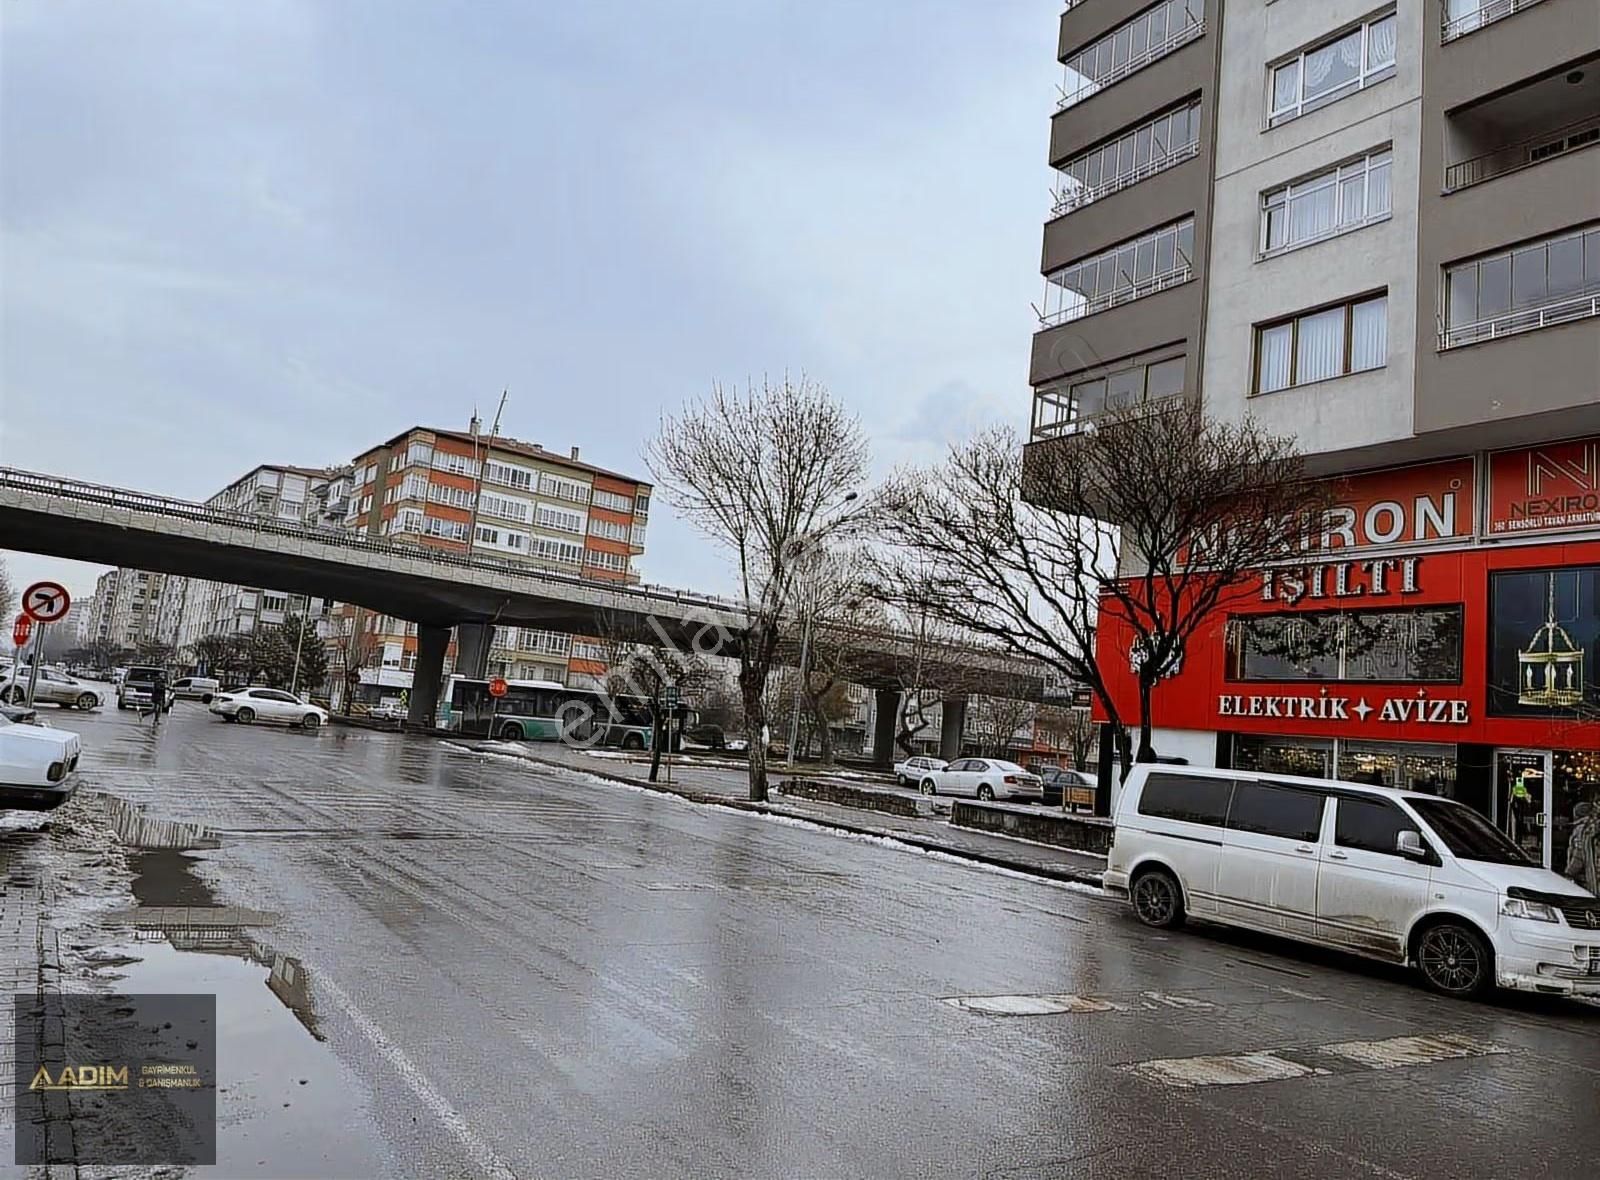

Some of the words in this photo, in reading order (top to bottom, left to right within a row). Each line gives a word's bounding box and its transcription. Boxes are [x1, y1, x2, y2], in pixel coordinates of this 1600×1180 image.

[1261, 556, 1418, 605] IŞILTI
[1218, 686, 1349, 720] ELEKTRİK
[1378, 687, 1470, 724] AVİZE
